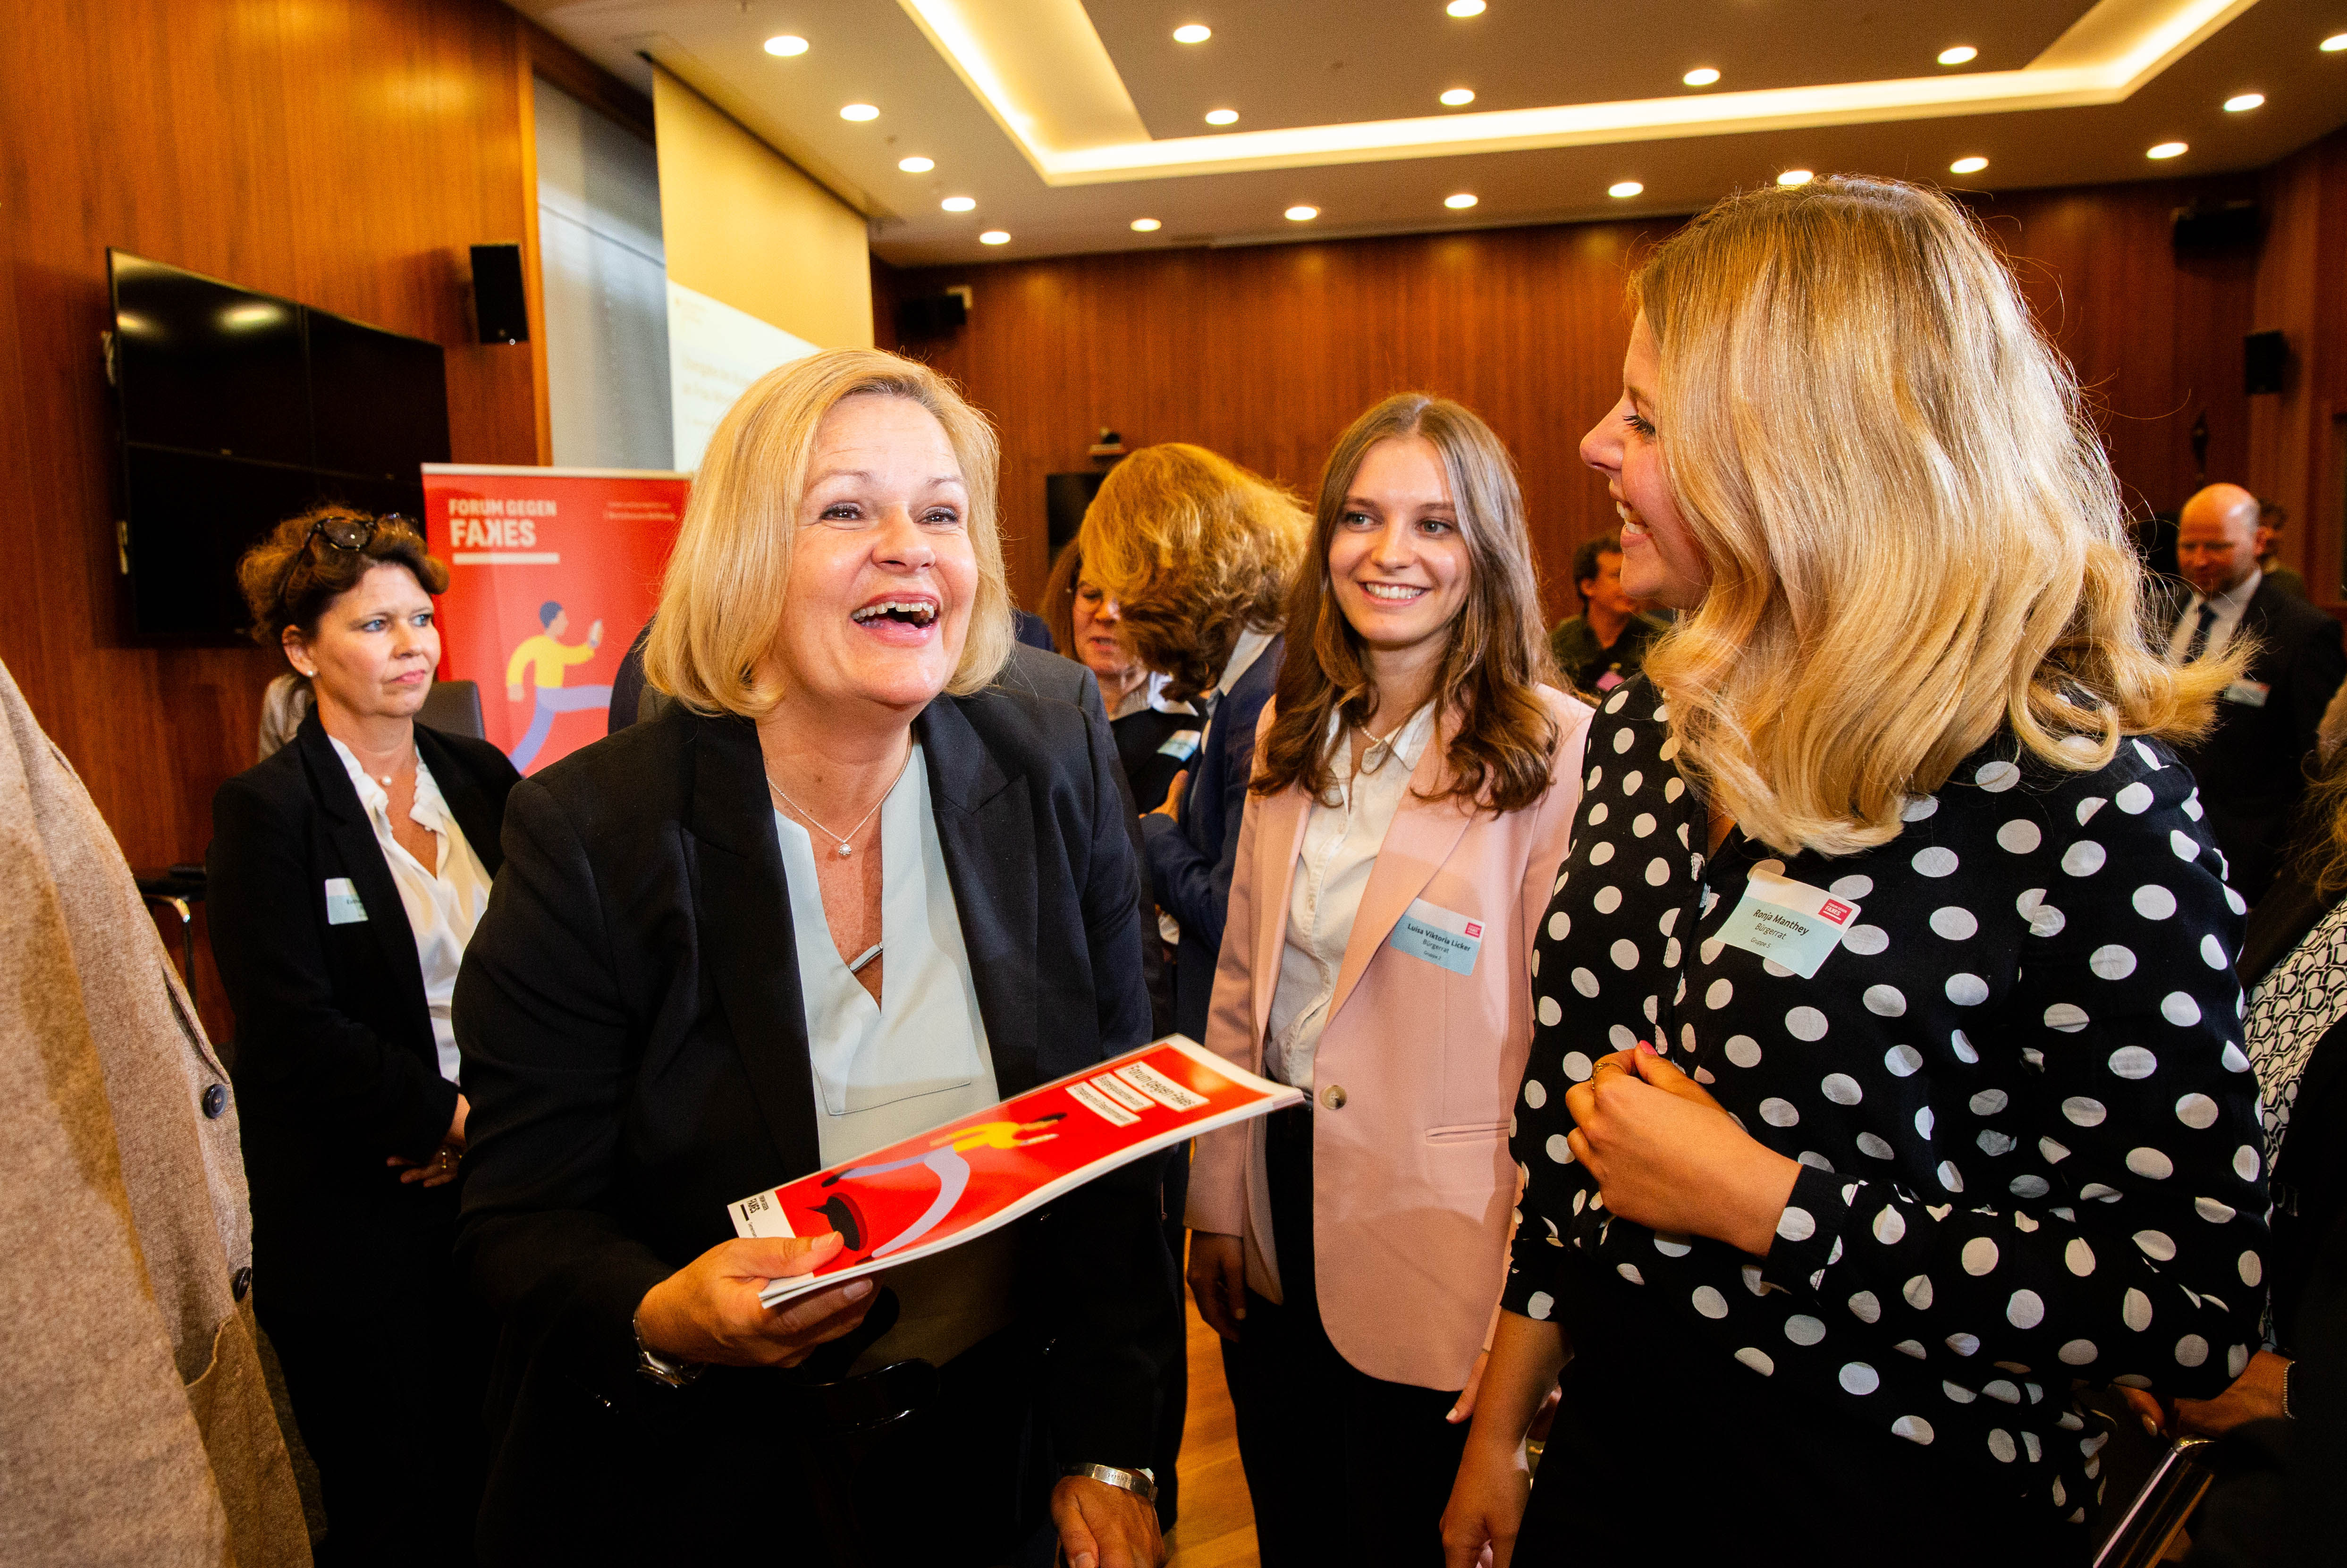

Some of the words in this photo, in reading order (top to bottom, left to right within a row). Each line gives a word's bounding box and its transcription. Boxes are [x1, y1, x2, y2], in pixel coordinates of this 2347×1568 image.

[449, 498, 504, 515] FORUM
[506, 499, 557, 516] GEGEN
[450, 518, 537, 548] FAKES
[1825, 905, 1841, 916] FAKES
[1753, 909, 1773, 921] Ronja
[1773, 914, 1809, 936] Manthey
[1755, 923, 1787, 940] Bürgerrat
[1408, 923, 1424, 934] Luisa
[1426, 930, 1450, 944] Viktoria
[1451, 939, 1471, 951] Licker
[1423, 939, 1449, 953] Bürgerrat
[1750, 937, 1767, 947] Gruppe
[1125, 1065, 1152, 1083] Forum
[1141, 1079, 1174, 1098] gegen
[1172, 1091, 1196, 1106] Fakes
